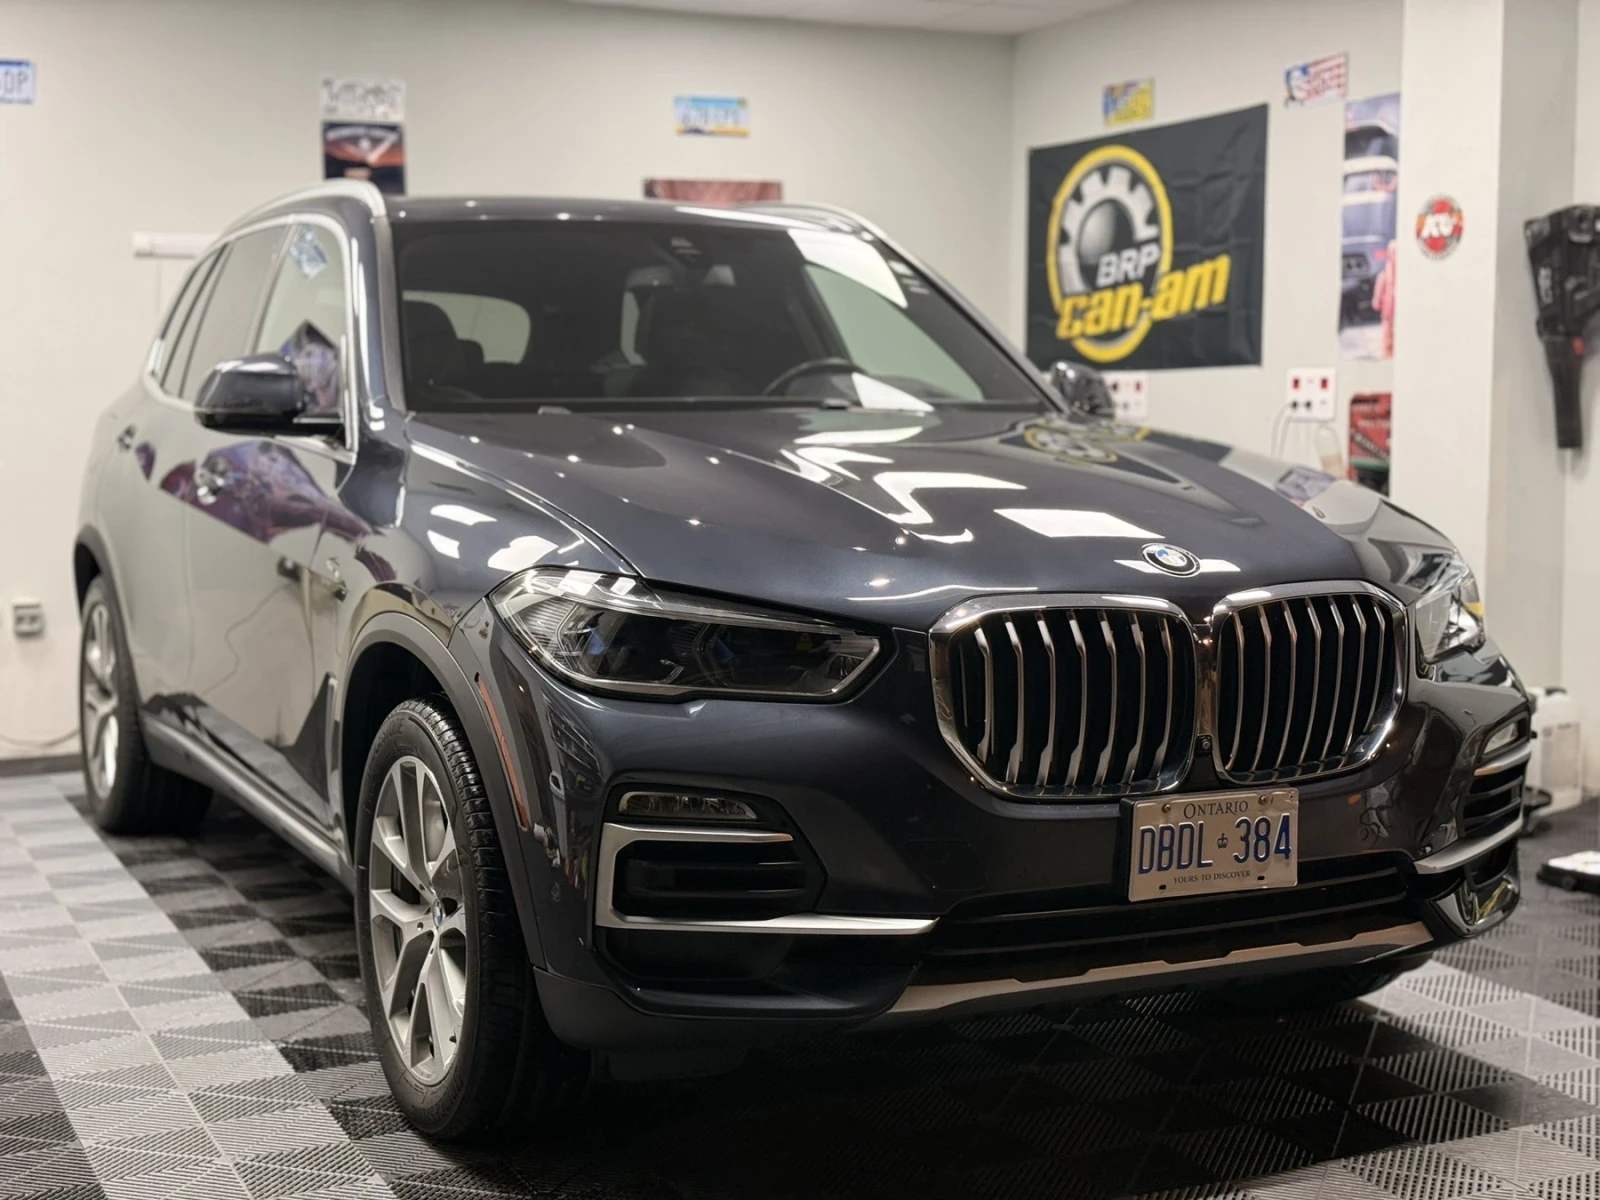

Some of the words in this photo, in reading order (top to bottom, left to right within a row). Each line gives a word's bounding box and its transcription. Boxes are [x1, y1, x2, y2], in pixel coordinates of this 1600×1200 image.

[1096, 243, 1160, 288] BRP
[1056, 253, 1231, 340] can-am
[1183, 800, 1249, 819] ONTARIO
[1138, 820, 1214, 875] DBDL
[1232, 812, 1293, 864] 384
[1173, 876, 1199, 884] YOURS
[1213, 870, 1251, 880] DISCOVER
